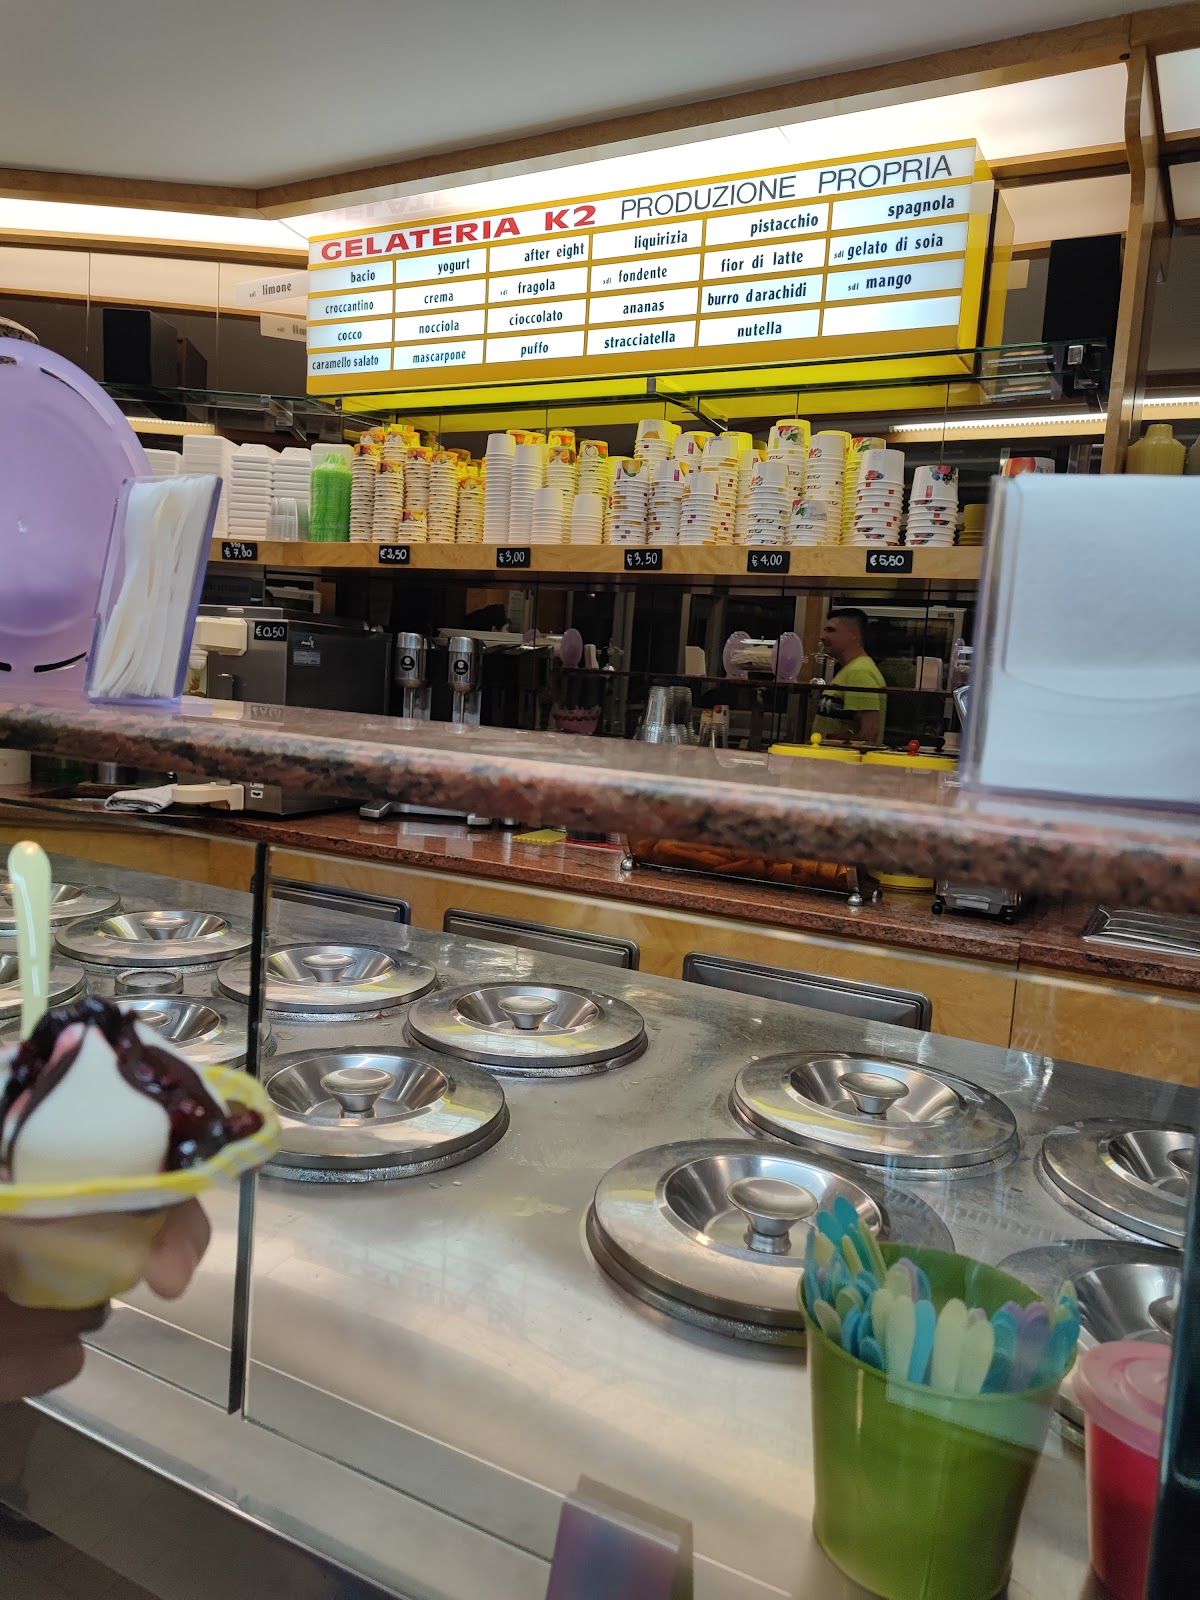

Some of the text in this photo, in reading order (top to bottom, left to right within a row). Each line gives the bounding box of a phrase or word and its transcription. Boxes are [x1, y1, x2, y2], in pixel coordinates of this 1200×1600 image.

[321, 154, 953, 261] GELATERIA K2 PRODUZIONE PROPRIA
[887, 195, 955, 220] spagnola
[750, 213, 819, 236] pistacchio
[634, 230, 688, 250] liquirizia
[847, 240, 888, 262] gelato
[895, 237, 908, 252] di
[914, 233, 944, 250] soia
[524, 242, 585, 262] after eight
[437, 258, 471, 275] yogurt
[721, 249, 804, 273] fior di latte
[350, 270, 376, 283] bacio
[618, 264, 668, 283] fondente
[865, 273, 912, 291] mango
[262, 282, 292, 296] limone
[517, 278, 556, 295] fragola
[707, 282, 807, 307] burro darachidi
[424, 291, 454, 304] crema
[325, 299, 374, 315] croccantino
[622, 301, 666, 315] ananas
[418, 319, 460, 335] nocciola
[509, 310, 563, 327] cioccolato
[337, 330, 363, 341] cocco
[737, 321, 783, 339] nutella
[603, 330, 677, 350] stracciatella
[412, 349, 466, 368] mascarpone
[520, 342, 549, 358] puffo
[312, 354, 379, 370] caramello salato
[379, 548, 407, 560] €2,50
[869, 554, 905, 567] €5,50
[255, 624, 285, 639] €0,50
